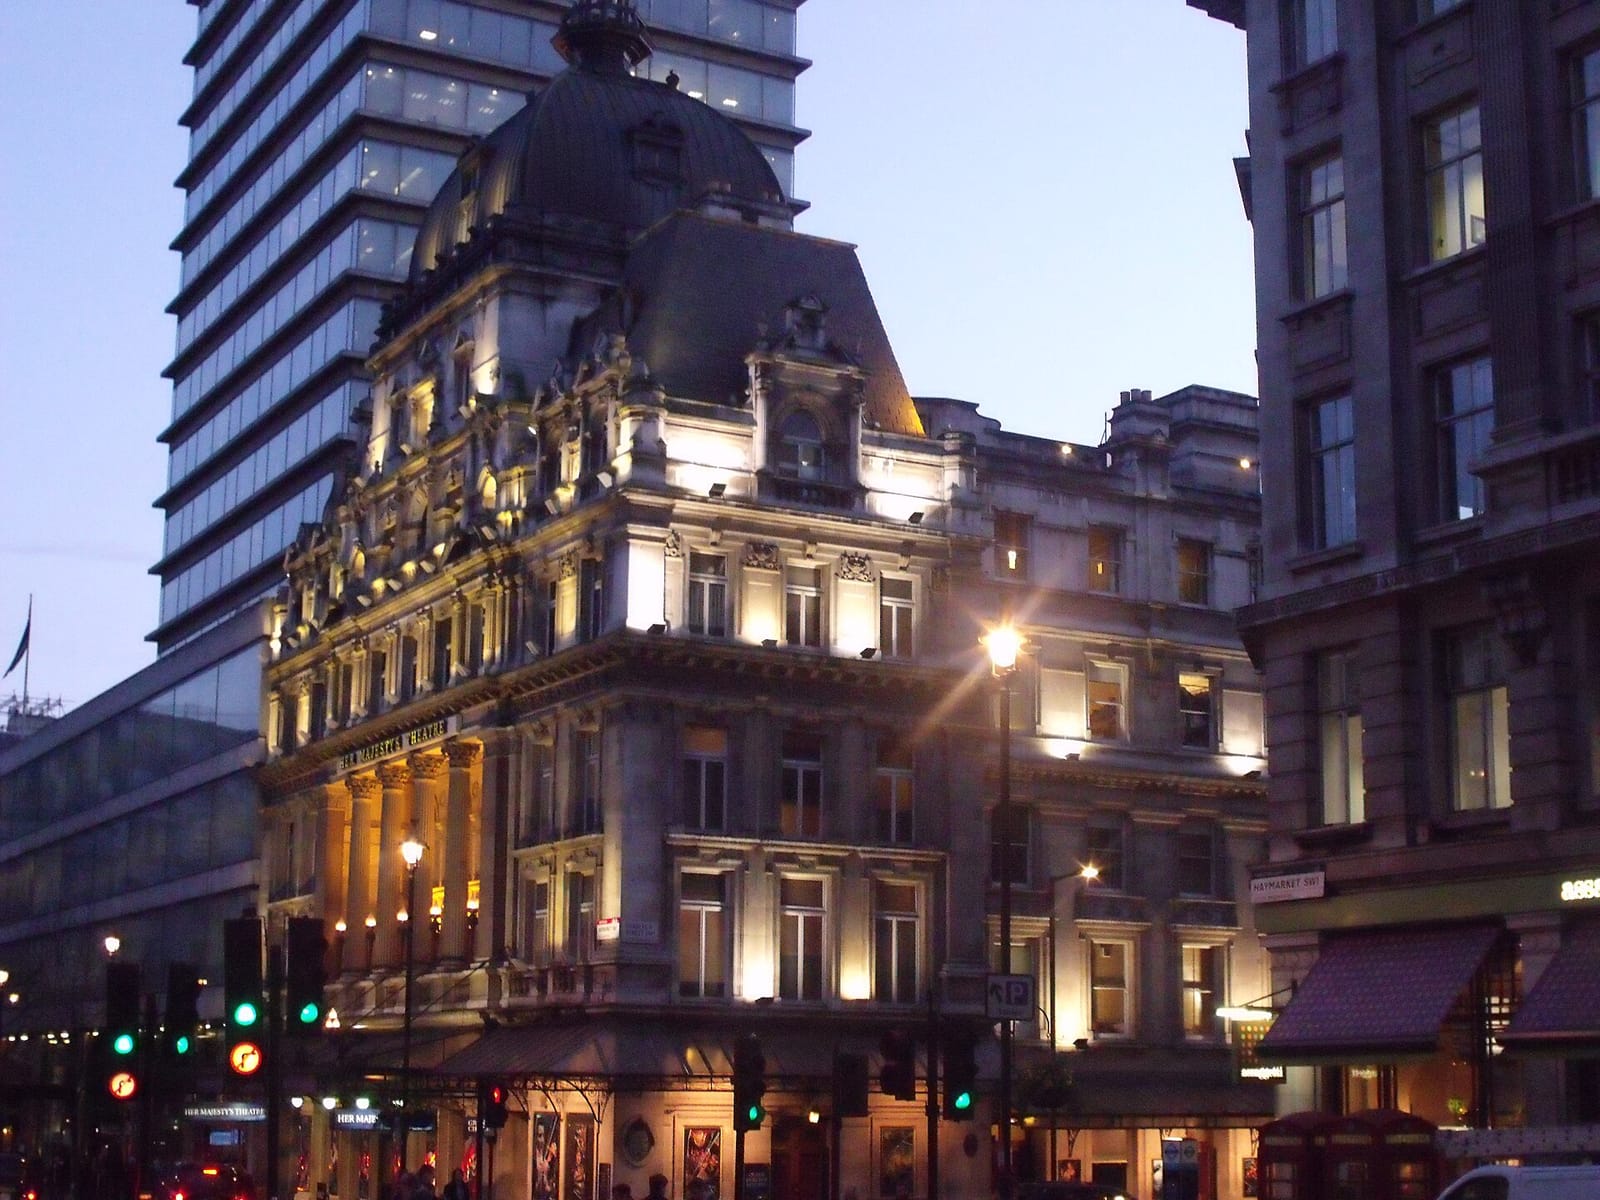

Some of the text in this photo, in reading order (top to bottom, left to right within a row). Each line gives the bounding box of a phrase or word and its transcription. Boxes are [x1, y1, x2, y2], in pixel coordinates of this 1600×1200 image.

[340, 752, 357, 769] HER
[408, 719, 446, 746] THEATRE
[1253, 876, 1321, 893] HAYMARKET SW1
[184, 1107, 199, 1116] HER
[337, 1114, 355, 1124] HER
